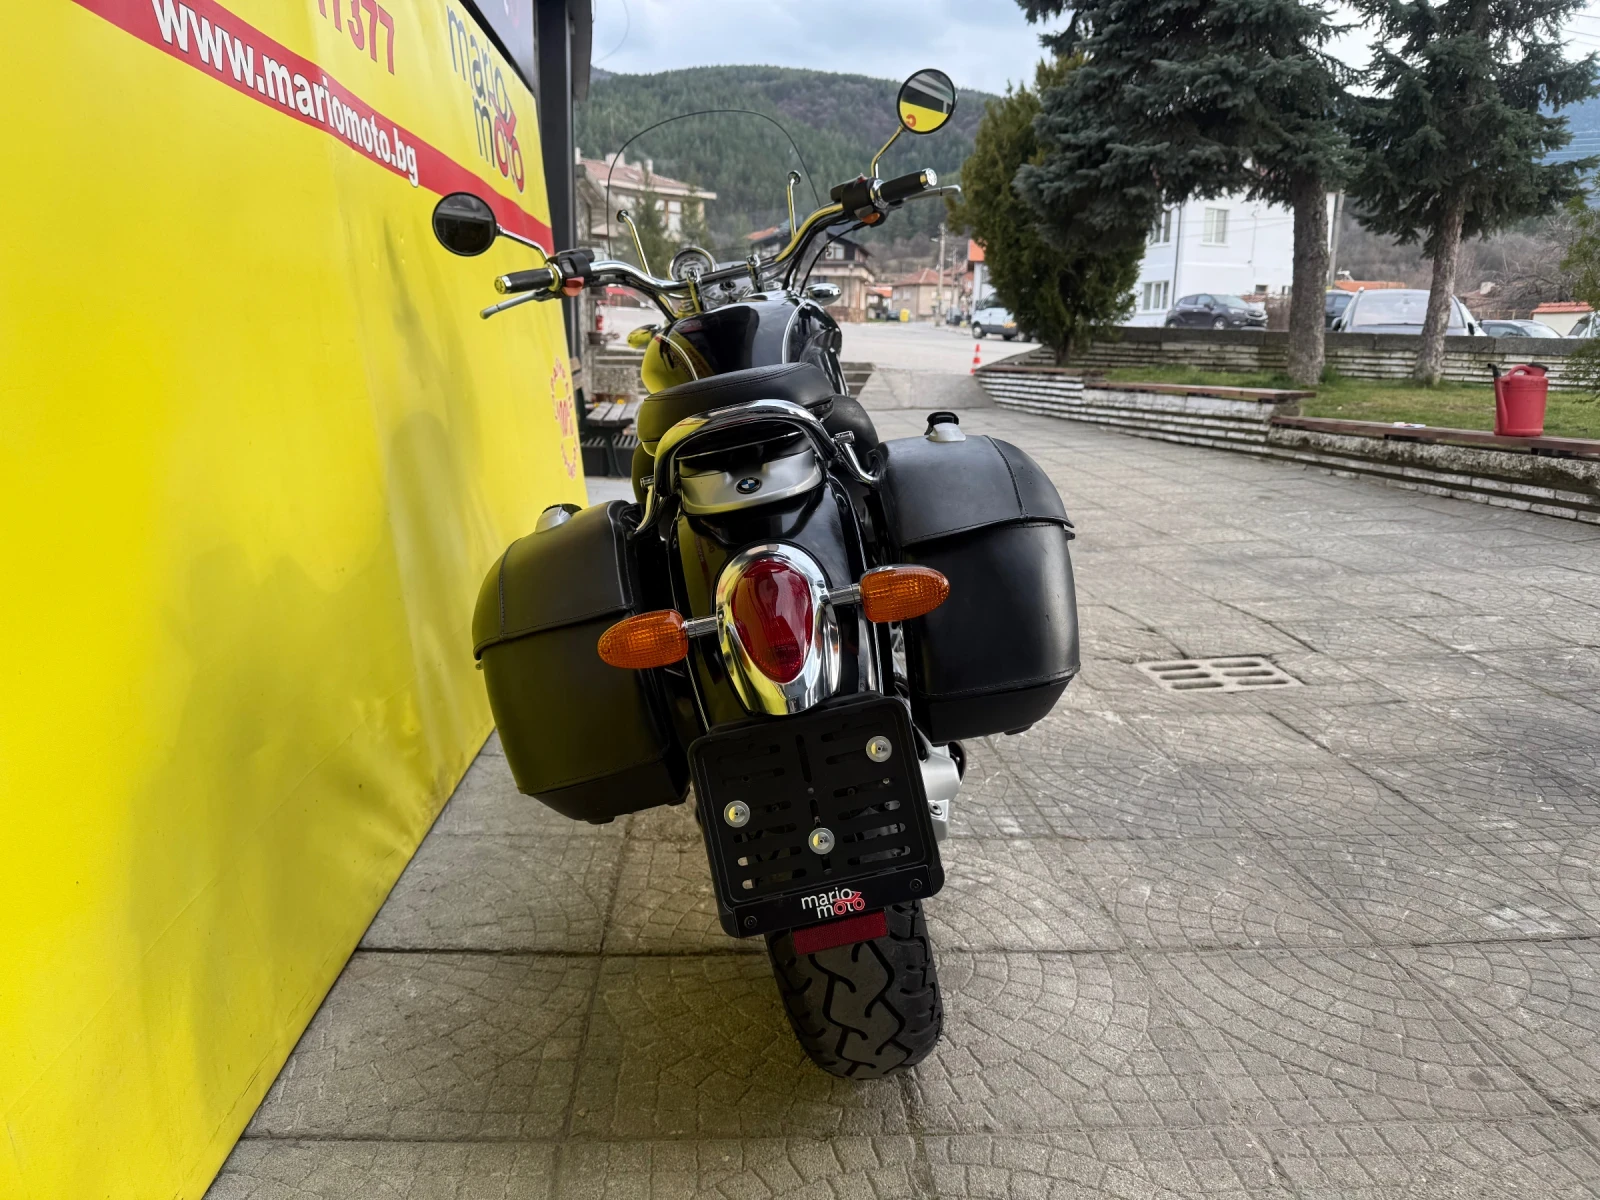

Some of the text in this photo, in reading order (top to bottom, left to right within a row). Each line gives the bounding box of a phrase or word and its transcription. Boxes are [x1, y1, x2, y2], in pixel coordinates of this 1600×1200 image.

[151, 0, 419, 188] www.mariomoto.bg
[446, 4, 510, 123] mario
[472, 95, 525, 193] moto
[801, 887, 852, 910] mario
[816, 898, 865, 918] moto
